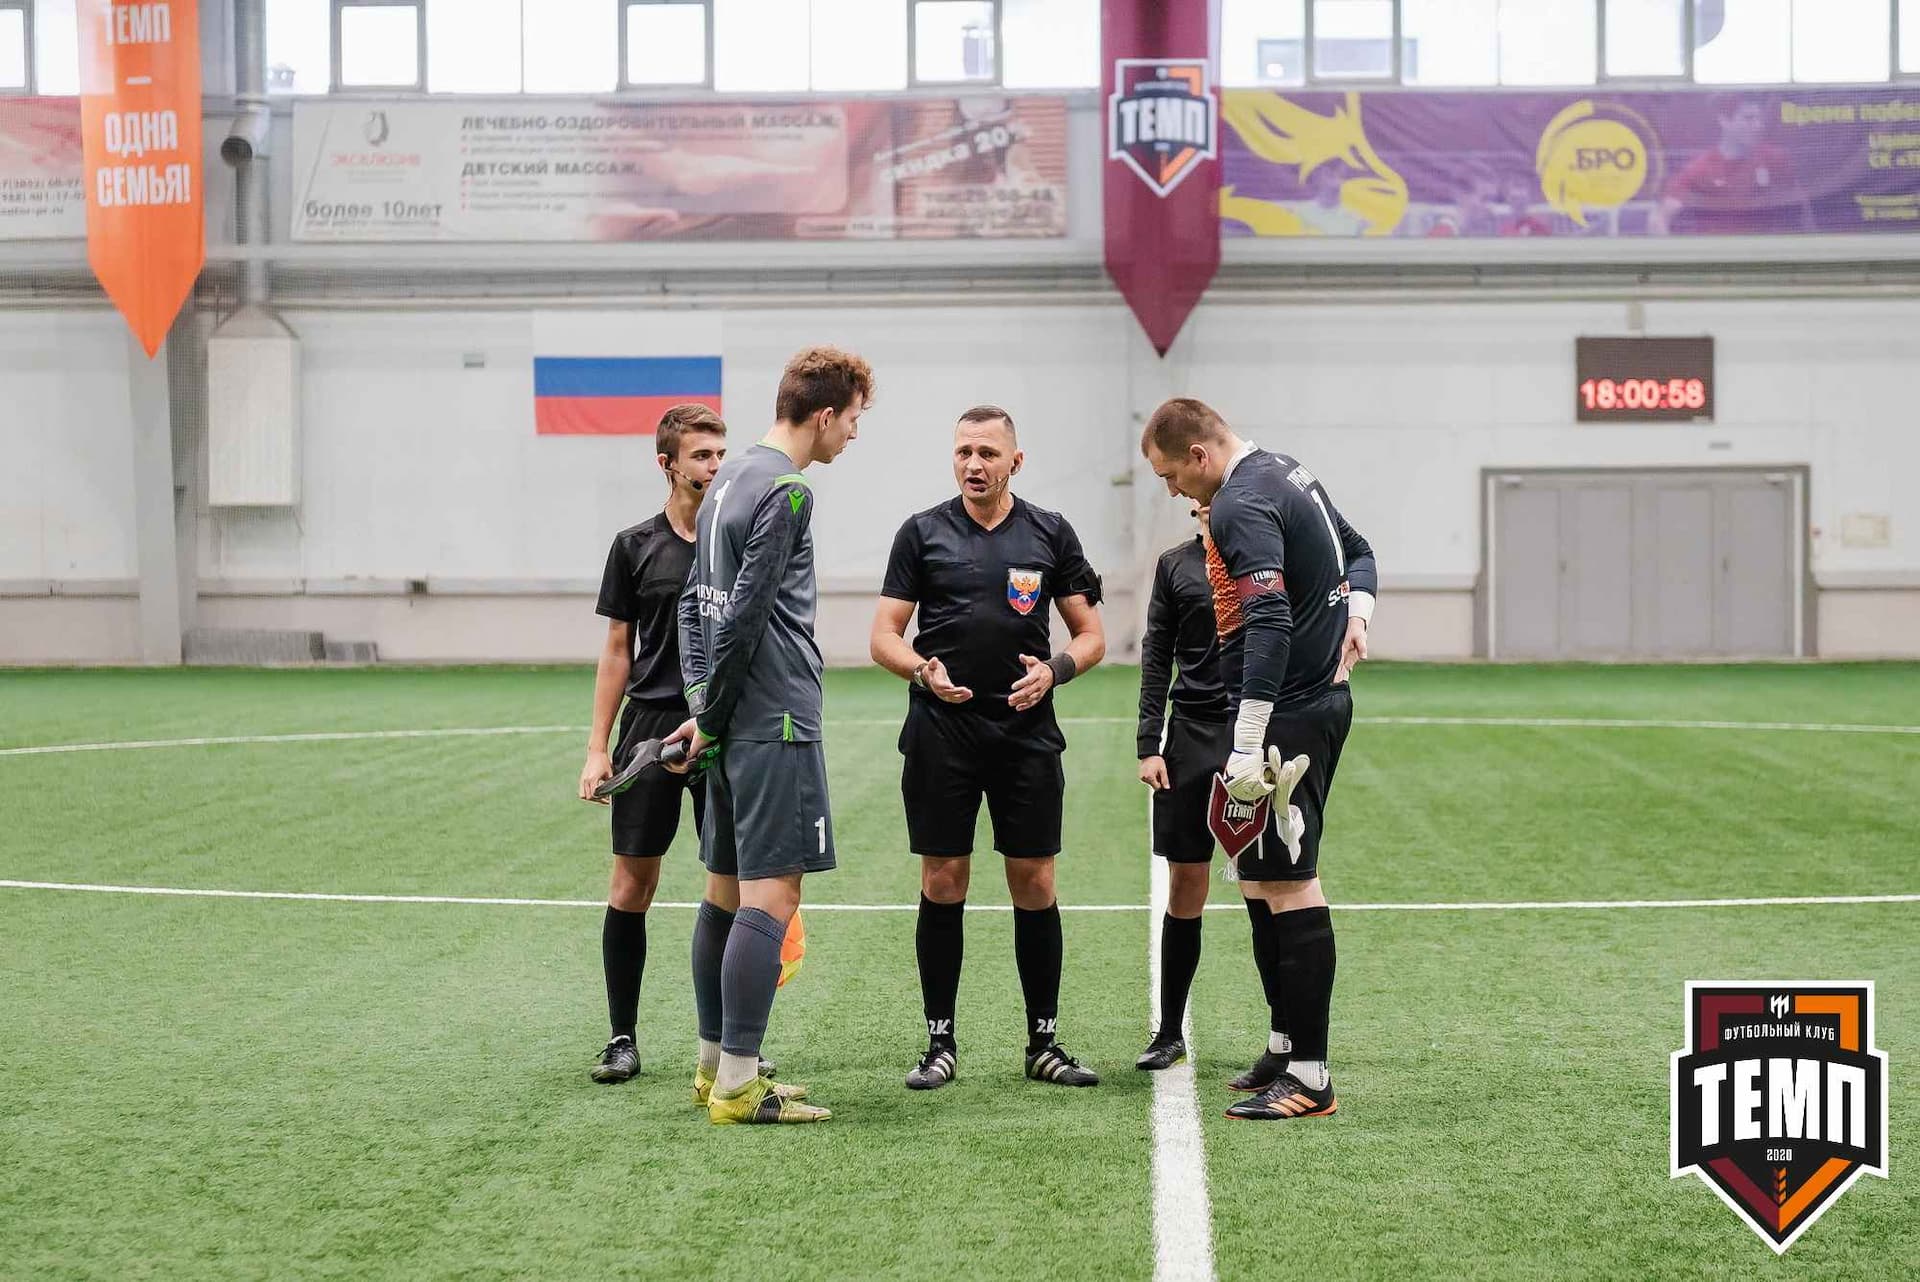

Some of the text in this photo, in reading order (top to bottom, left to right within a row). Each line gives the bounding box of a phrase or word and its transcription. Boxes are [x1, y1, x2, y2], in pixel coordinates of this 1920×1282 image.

[102, 3, 170, 46] ТЕМП
[104, 110, 178, 158] ОДНА
[1119, 97, 1206, 145] ТЕМП
[96, 163, 191, 207] СЕМЬЯ!
[461, 159, 549, 177] ДЕТСКИЙ
[305, 199, 373, 219] более
[1580, 378, 1706, 409] 18:00:58
[709, 479, 731, 573] 1
[1311, 488, 1345, 577] 1
[814, 816, 826, 854] 1
